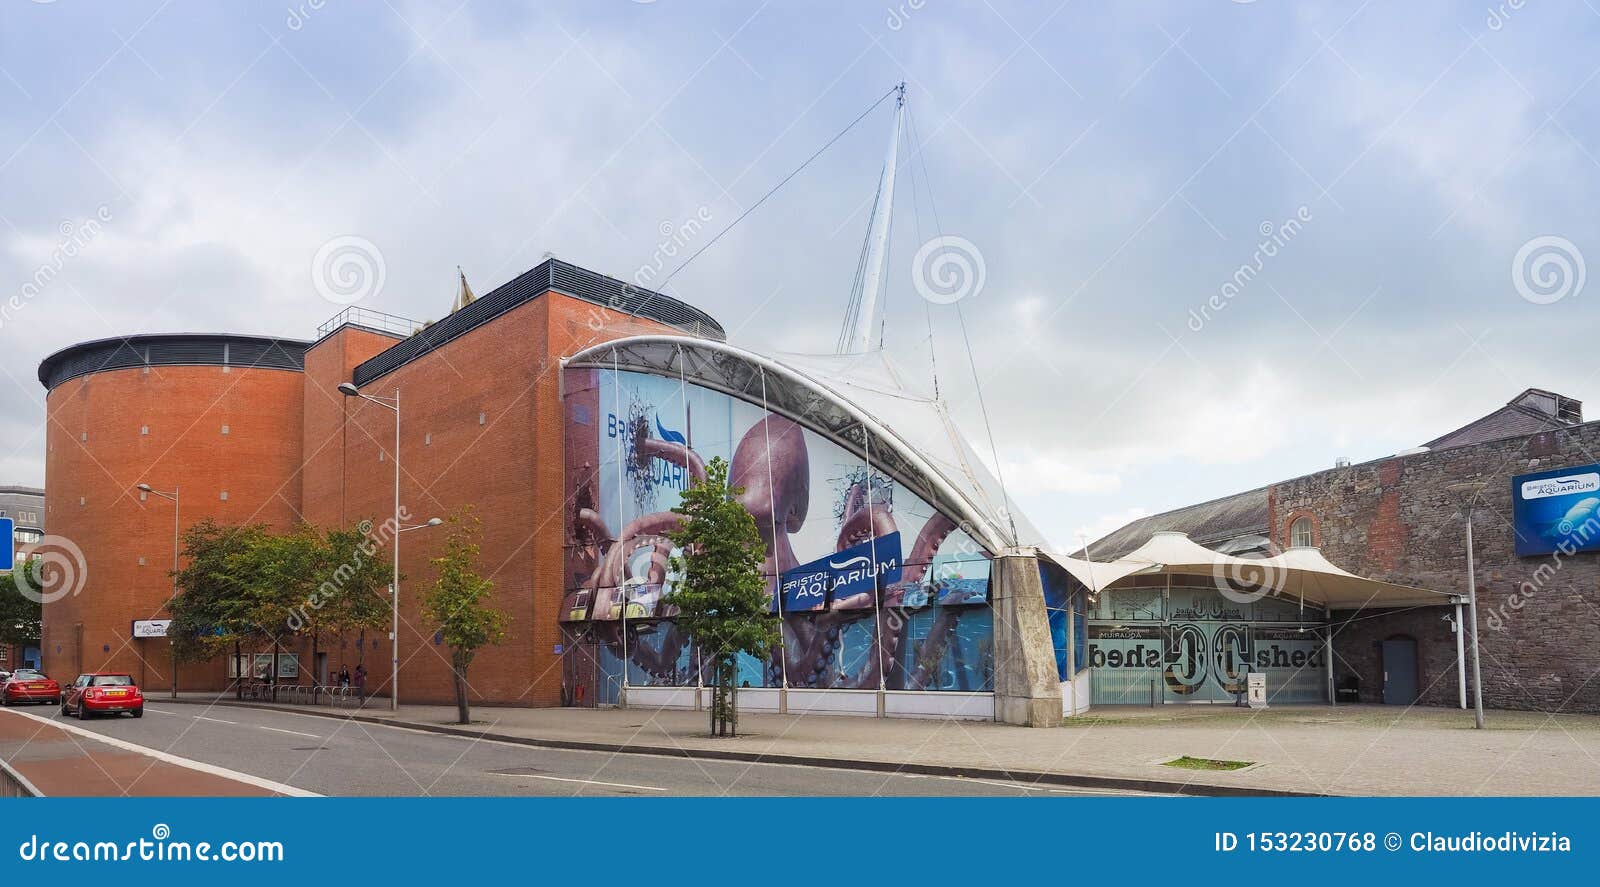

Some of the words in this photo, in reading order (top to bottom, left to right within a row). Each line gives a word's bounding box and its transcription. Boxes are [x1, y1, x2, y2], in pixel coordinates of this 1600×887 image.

[783, 571, 832, 593] BRISTOL
[795, 558, 896, 600] AQUARIUM
[1257, 645, 1325, 667] shed
